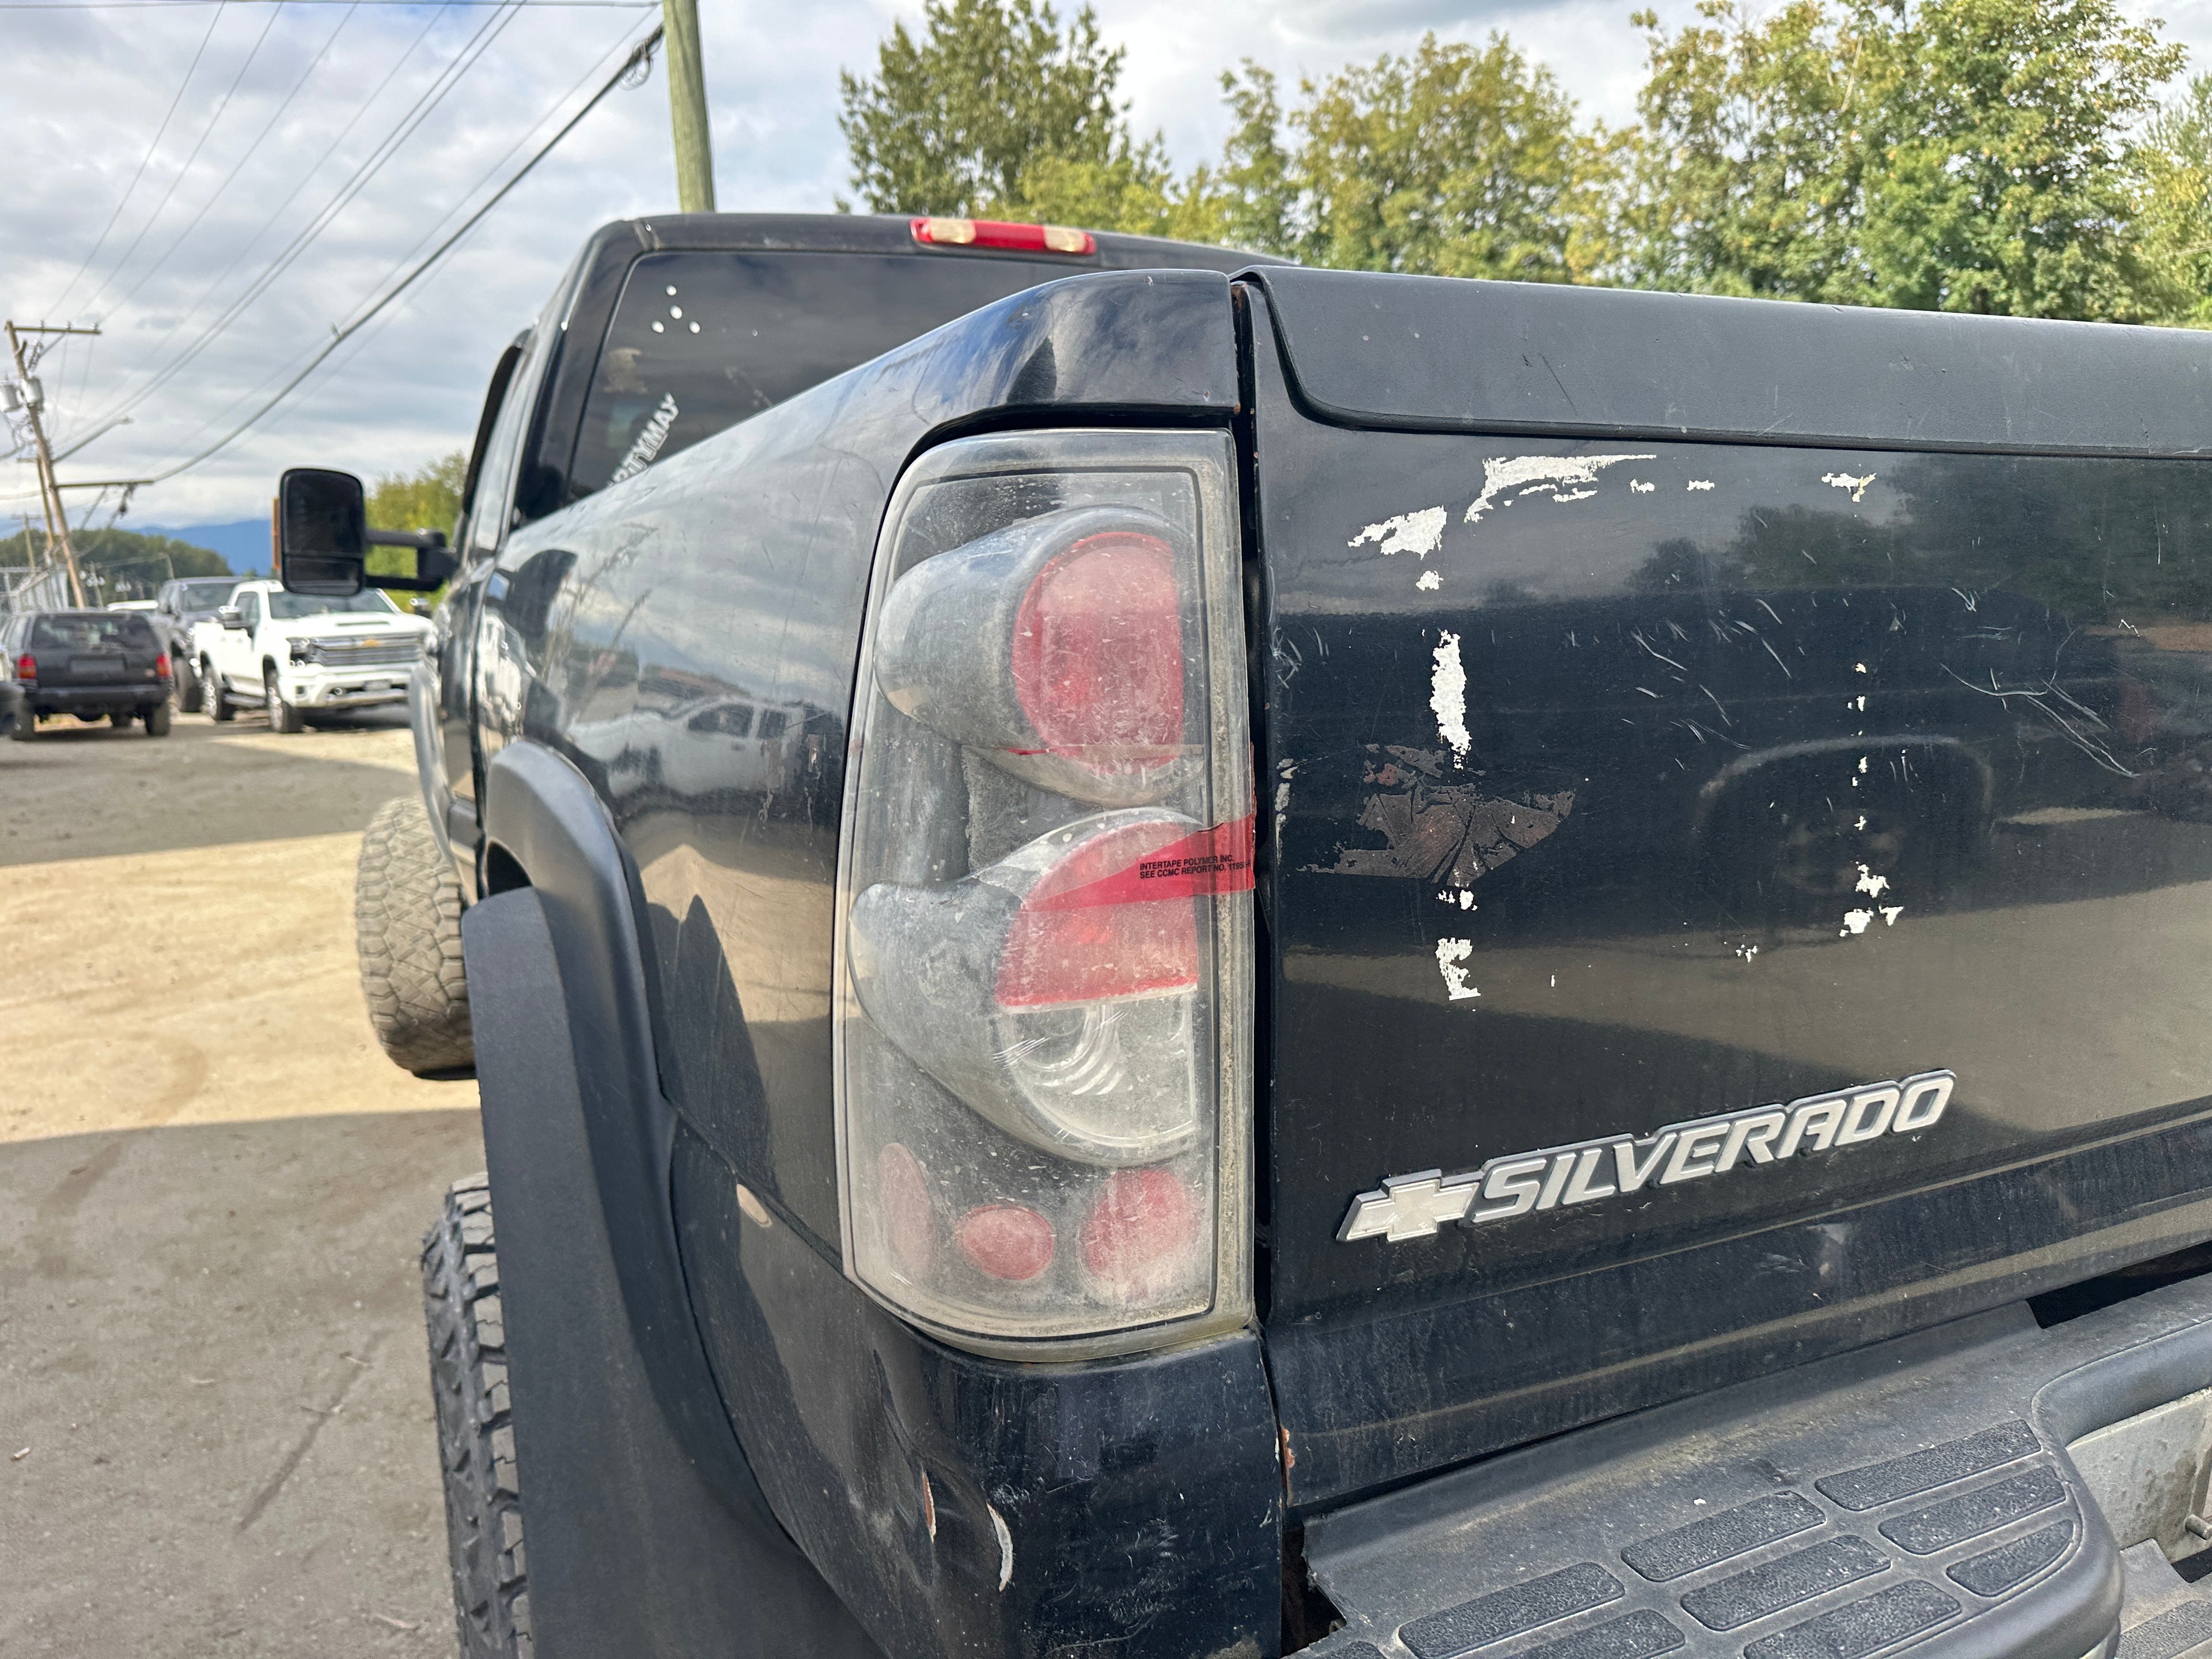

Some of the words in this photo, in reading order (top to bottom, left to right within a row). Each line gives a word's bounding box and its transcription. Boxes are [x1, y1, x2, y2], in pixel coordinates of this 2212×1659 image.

[1140, 859, 1181, 870] INTERTAPE
[1184, 855, 1218, 866] POLYMER
[1220, 854, 1234, 863] INC.
[1140, 870, 1155, 878] SEE
[1157, 868, 1180, 877] CCMC
[1181, 864, 1212, 875] REPORT
[1213, 863, 1226, 872] NO.
[1471, 1077, 1955, 1224] SILVERADO
